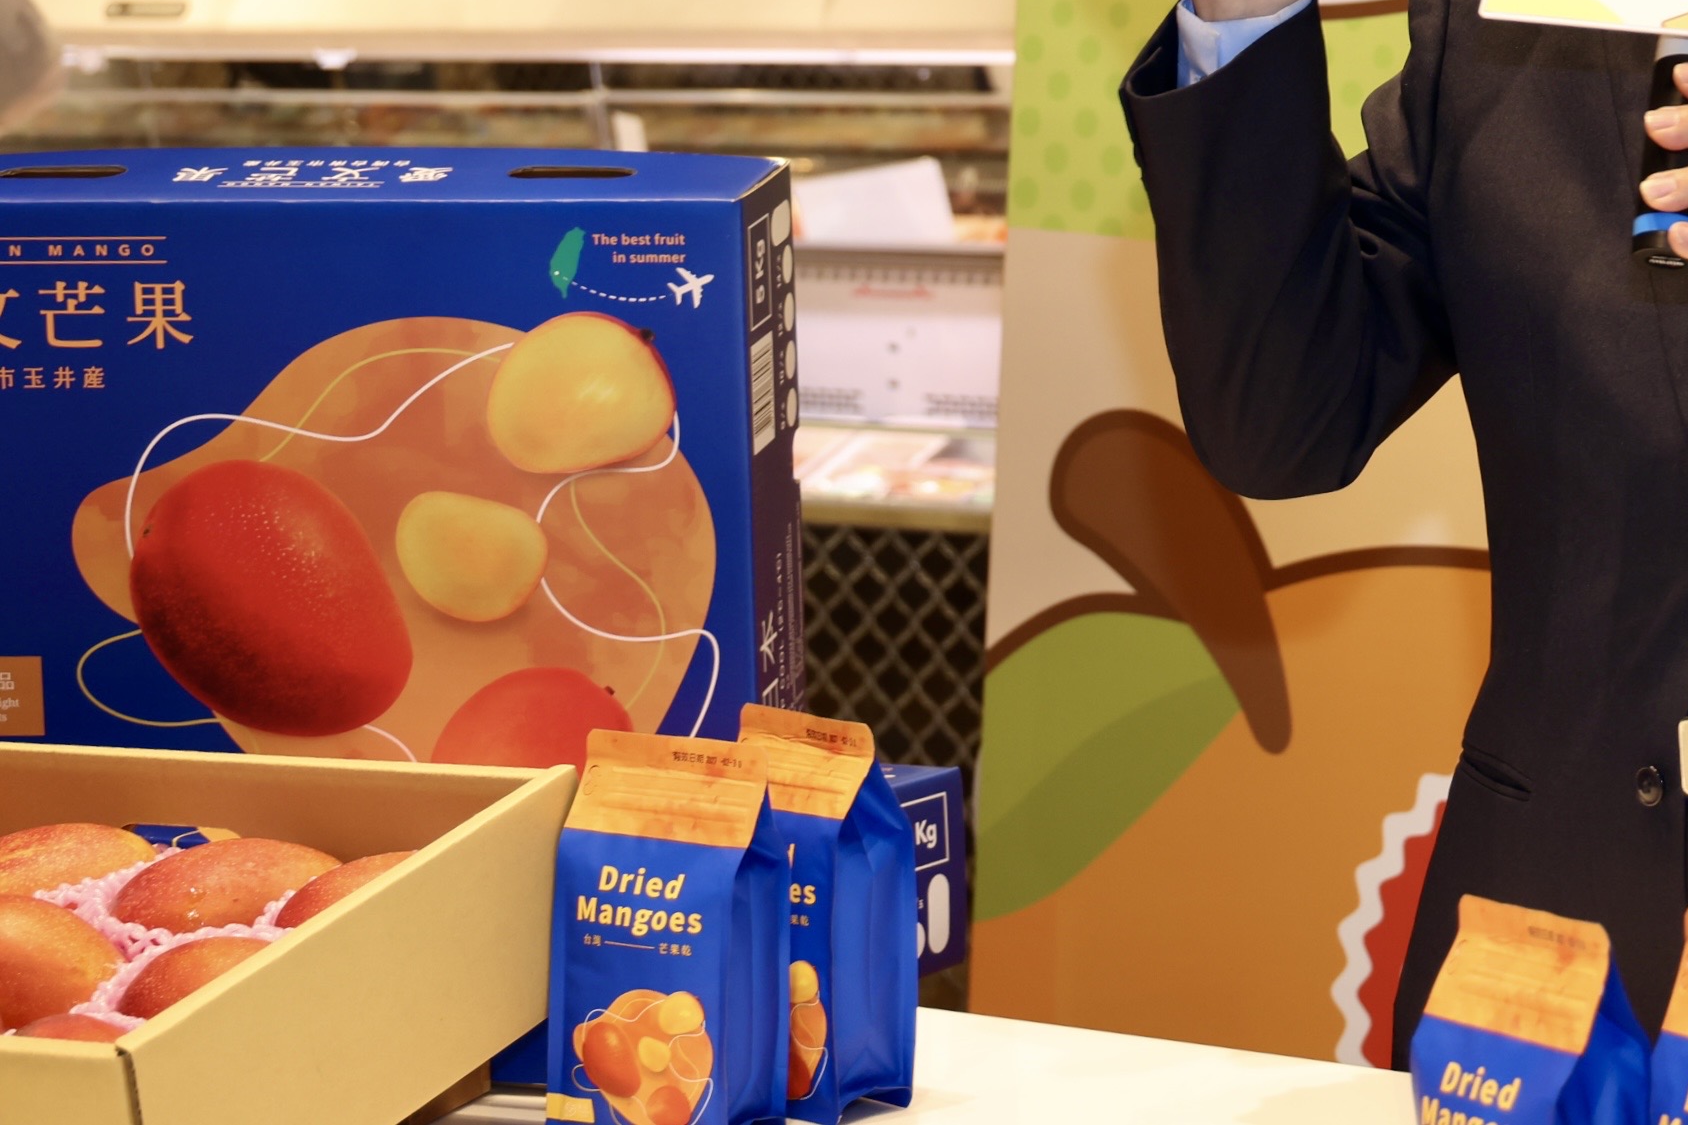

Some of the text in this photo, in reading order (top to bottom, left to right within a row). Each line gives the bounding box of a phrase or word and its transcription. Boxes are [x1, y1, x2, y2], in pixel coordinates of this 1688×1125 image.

[48, 243, 155, 257] MANGO
[592, 233, 686, 246] The best fruit
[612, 251, 687, 264] in summer
[915, 819, 938, 849] Kg
[598, 865, 685, 900] Dried
[577, 895, 703, 937] Mangoes
[1439, 1061, 1521, 1111] Dried
